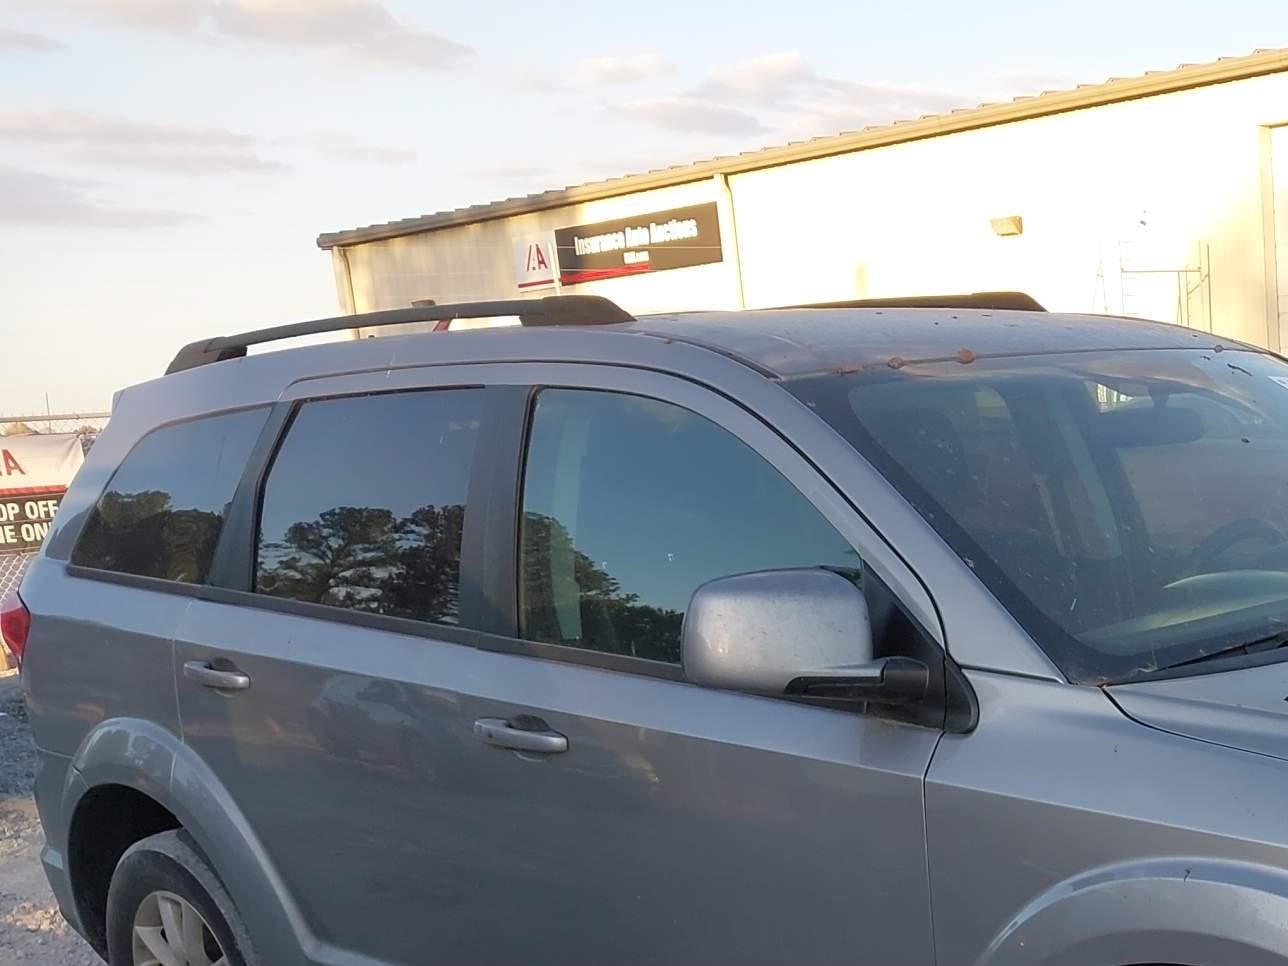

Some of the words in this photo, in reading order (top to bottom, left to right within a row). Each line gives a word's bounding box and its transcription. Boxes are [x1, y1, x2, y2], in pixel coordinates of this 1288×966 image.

[574, 231, 625, 256] Insurance
[625, 226, 650, 249] Auto
[650, 218, 698, 244] Auctions
[0, 449, 26, 476] A
[24, 499, 59, 520] OFF
[20, 521, 51, 543] ON
